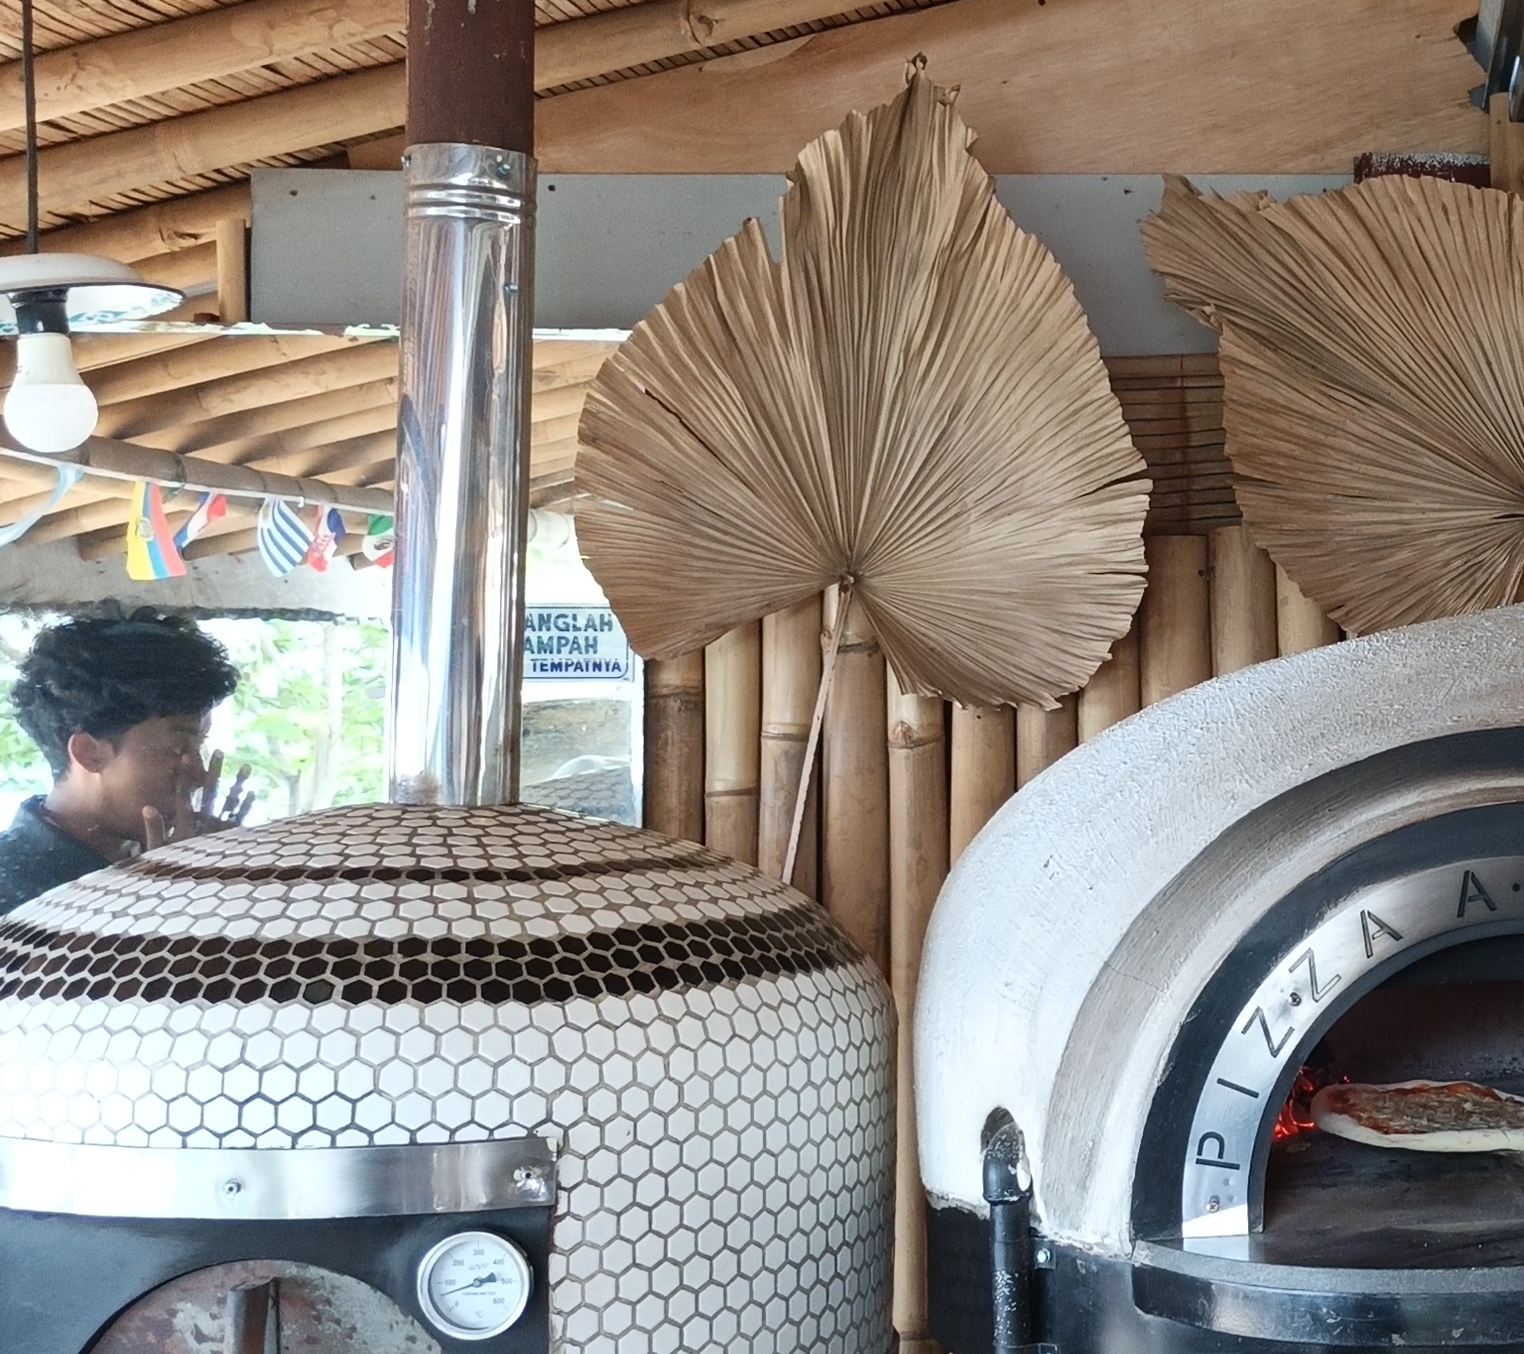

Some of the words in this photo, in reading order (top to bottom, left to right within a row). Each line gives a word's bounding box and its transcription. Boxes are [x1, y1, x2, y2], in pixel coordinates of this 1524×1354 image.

[524, 613, 613, 632] ANGLAH
[523, 636, 598, 655] AMPAH
[531, 658, 622, 673] TEMPATNYA
[1195, 909, 1403, 1170] PIZZA
